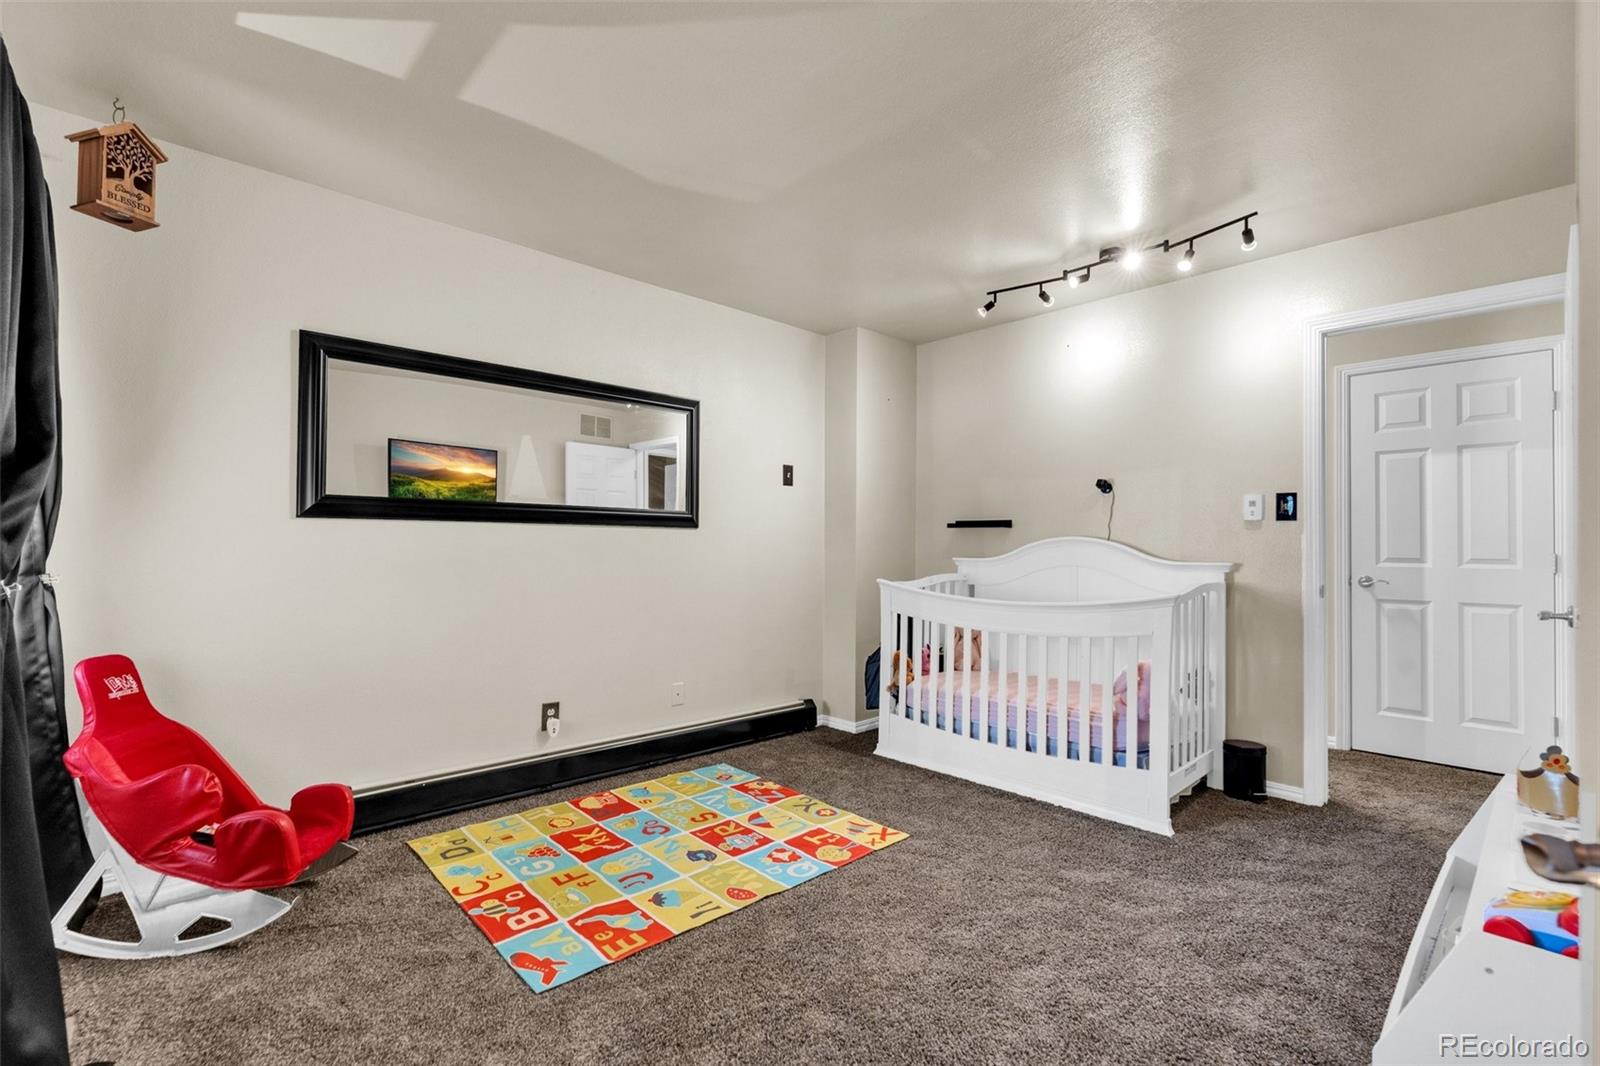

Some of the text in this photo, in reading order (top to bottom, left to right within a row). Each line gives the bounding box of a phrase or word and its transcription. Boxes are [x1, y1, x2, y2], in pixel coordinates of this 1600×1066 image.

[107, 191, 151, 213] BLESSED
[573, 828, 608, 841] K
[714, 822, 745, 836] R
[803, 835, 826, 844] T
[441, 846, 475, 860] D
[521, 860, 555, 875] G
[551, 872, 589, 887] F
[577, 880, 597, 888] f
[452, 880, 490, 896] C
[505, 891, 526, 902] b
[507, 907, 550, 931] B
[531, 929, 575, 948] A
[595, 930, 614, 941] e
[602, 933, 647, 959] E
